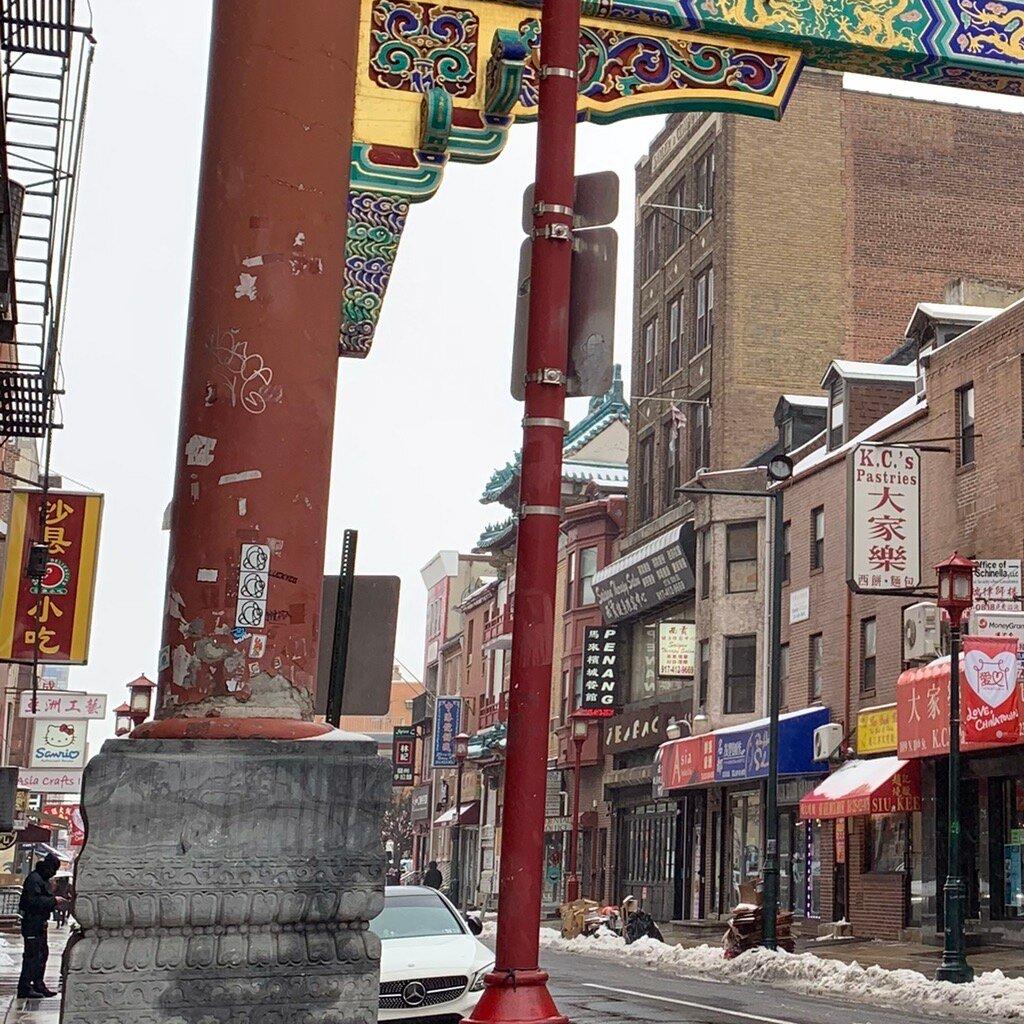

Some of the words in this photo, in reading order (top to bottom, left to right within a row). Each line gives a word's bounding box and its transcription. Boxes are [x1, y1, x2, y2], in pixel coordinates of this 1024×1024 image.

[856, 468, 918, 486] Pastries
[867, 486, 907, 572] 大家樂
[601, 629, 616, 705] PENANG
[35, 747, 79, 759] Sanrio
[42, 775, 74, 788] Crafts
